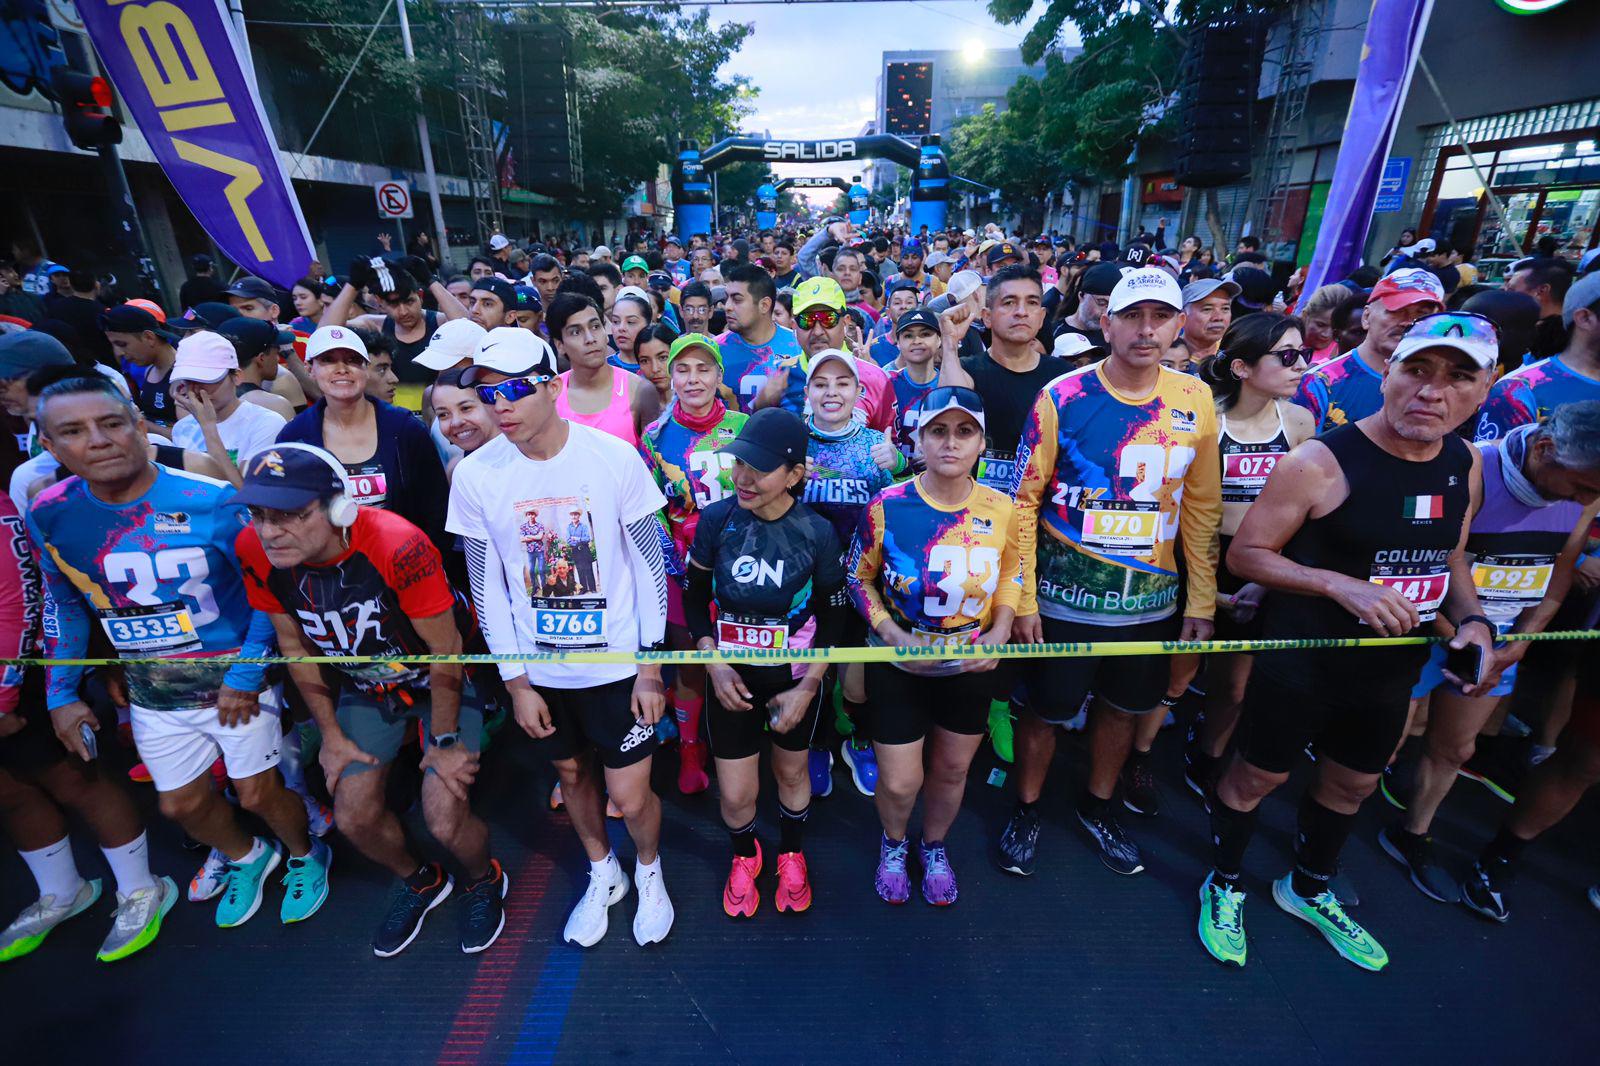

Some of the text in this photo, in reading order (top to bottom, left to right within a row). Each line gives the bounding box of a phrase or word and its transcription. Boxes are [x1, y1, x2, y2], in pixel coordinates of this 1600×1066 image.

[107, 0, 274, 262] VIB
[763, 140, 856, 160] SALIDA
[793, 178, 833, 187] SALIDA
[1239, 456, 1276, 475] 073
[1101, 514, 1142, 534] 970
[731, 555, 785, 589] ON
[923, 544, 1001, 617] 33
[1489, 569, 1537, 588] 995
[113, 616, 181, 640] 3535
[541, 613, 597, 634] 3766
[735, 627, 773, 647] 180
[620, 723, 655, 752] adida
